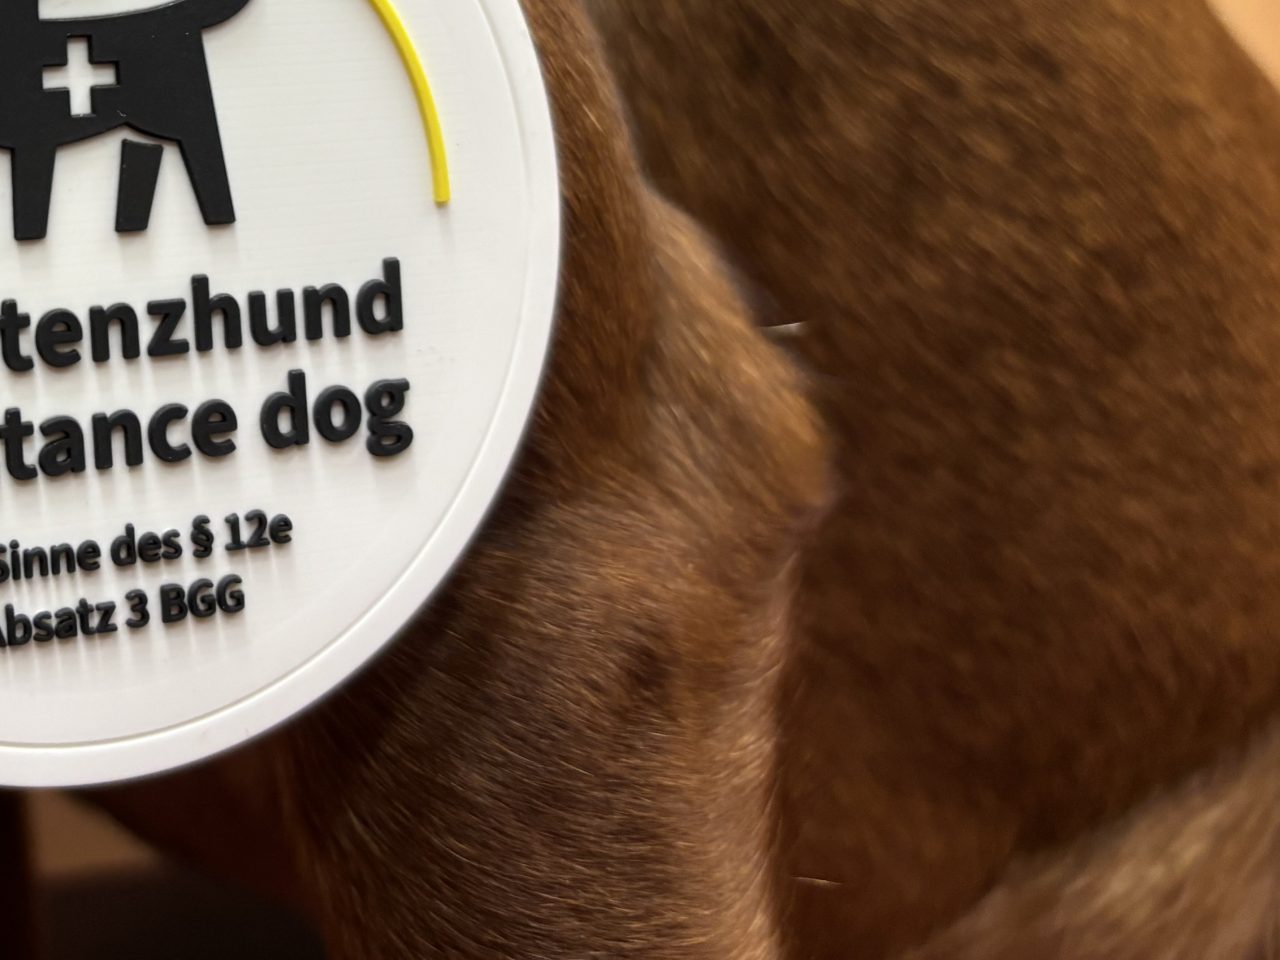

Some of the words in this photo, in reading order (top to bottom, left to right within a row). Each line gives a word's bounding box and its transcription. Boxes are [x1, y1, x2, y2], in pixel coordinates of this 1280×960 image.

[259, 368, 414, 461] dog
[109, 522, 183, 570] des
[190, 514, 215, 561] §
[224, 509, 293, 554] 12e
[124, 588, 150, 631] 3
[159, 573, 246, 627] BGG
